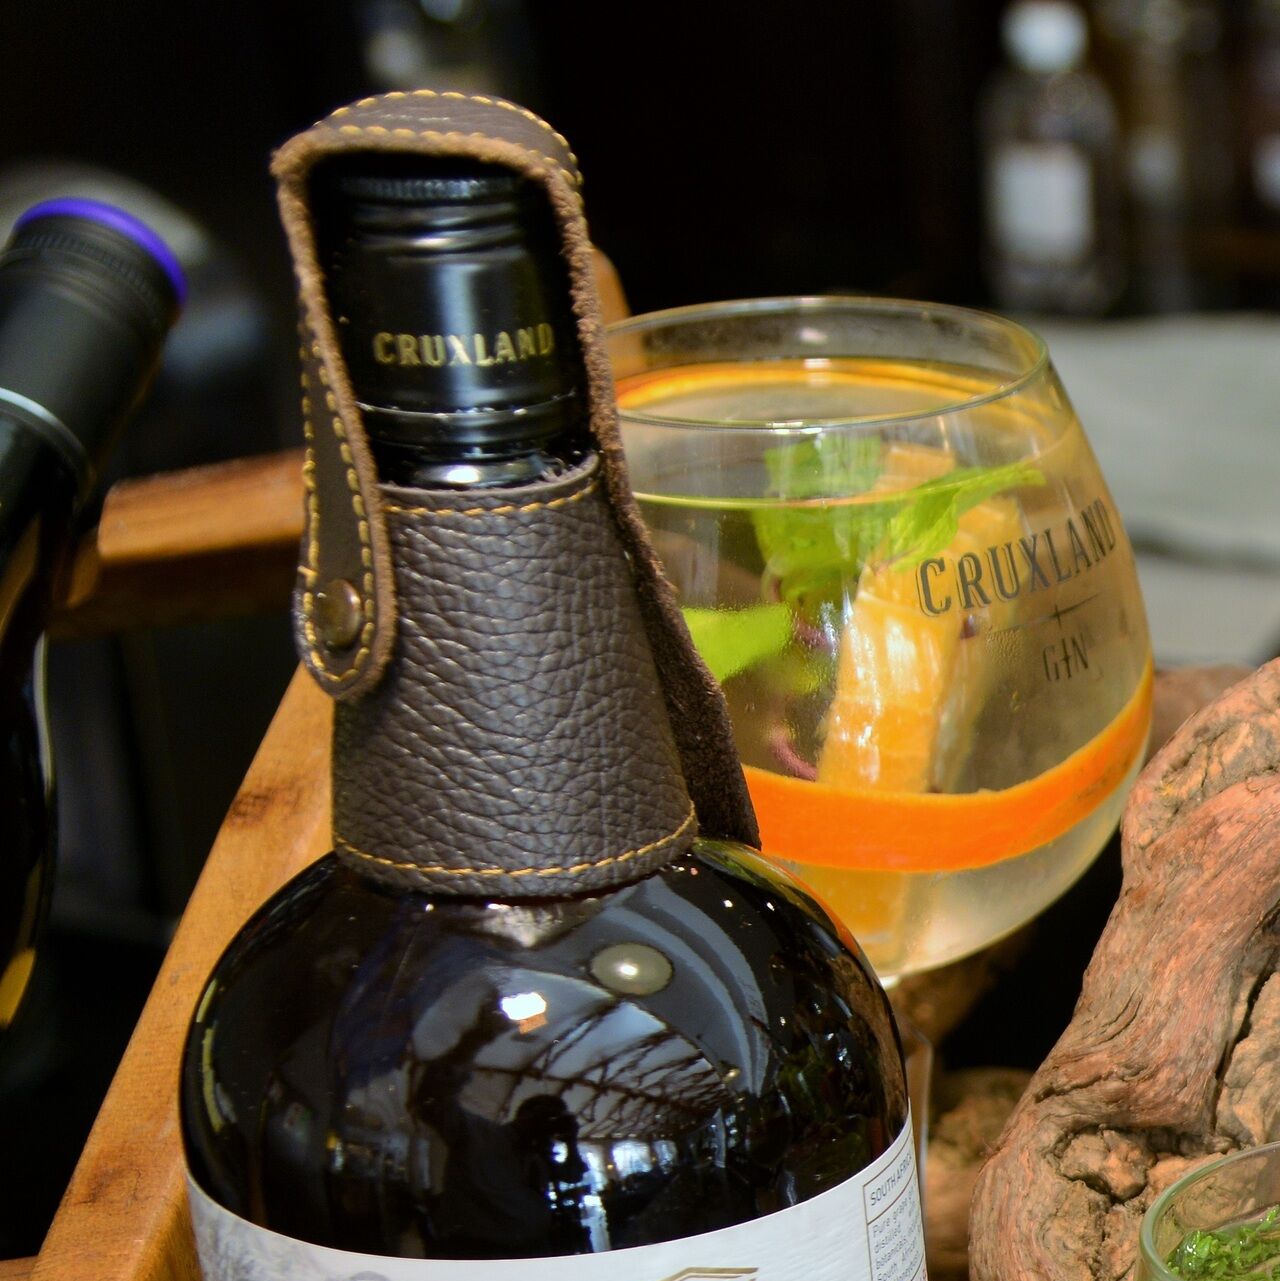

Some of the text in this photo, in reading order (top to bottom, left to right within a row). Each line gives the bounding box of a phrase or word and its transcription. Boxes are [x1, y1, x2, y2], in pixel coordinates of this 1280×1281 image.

[374, 323, 555, 368] CRUXLAND
[915, 497, 1117, 618] CRUXLAND
[1042, 631, 1090, 683] GIN
[870, 1174, 896, 1207] SOUTH
